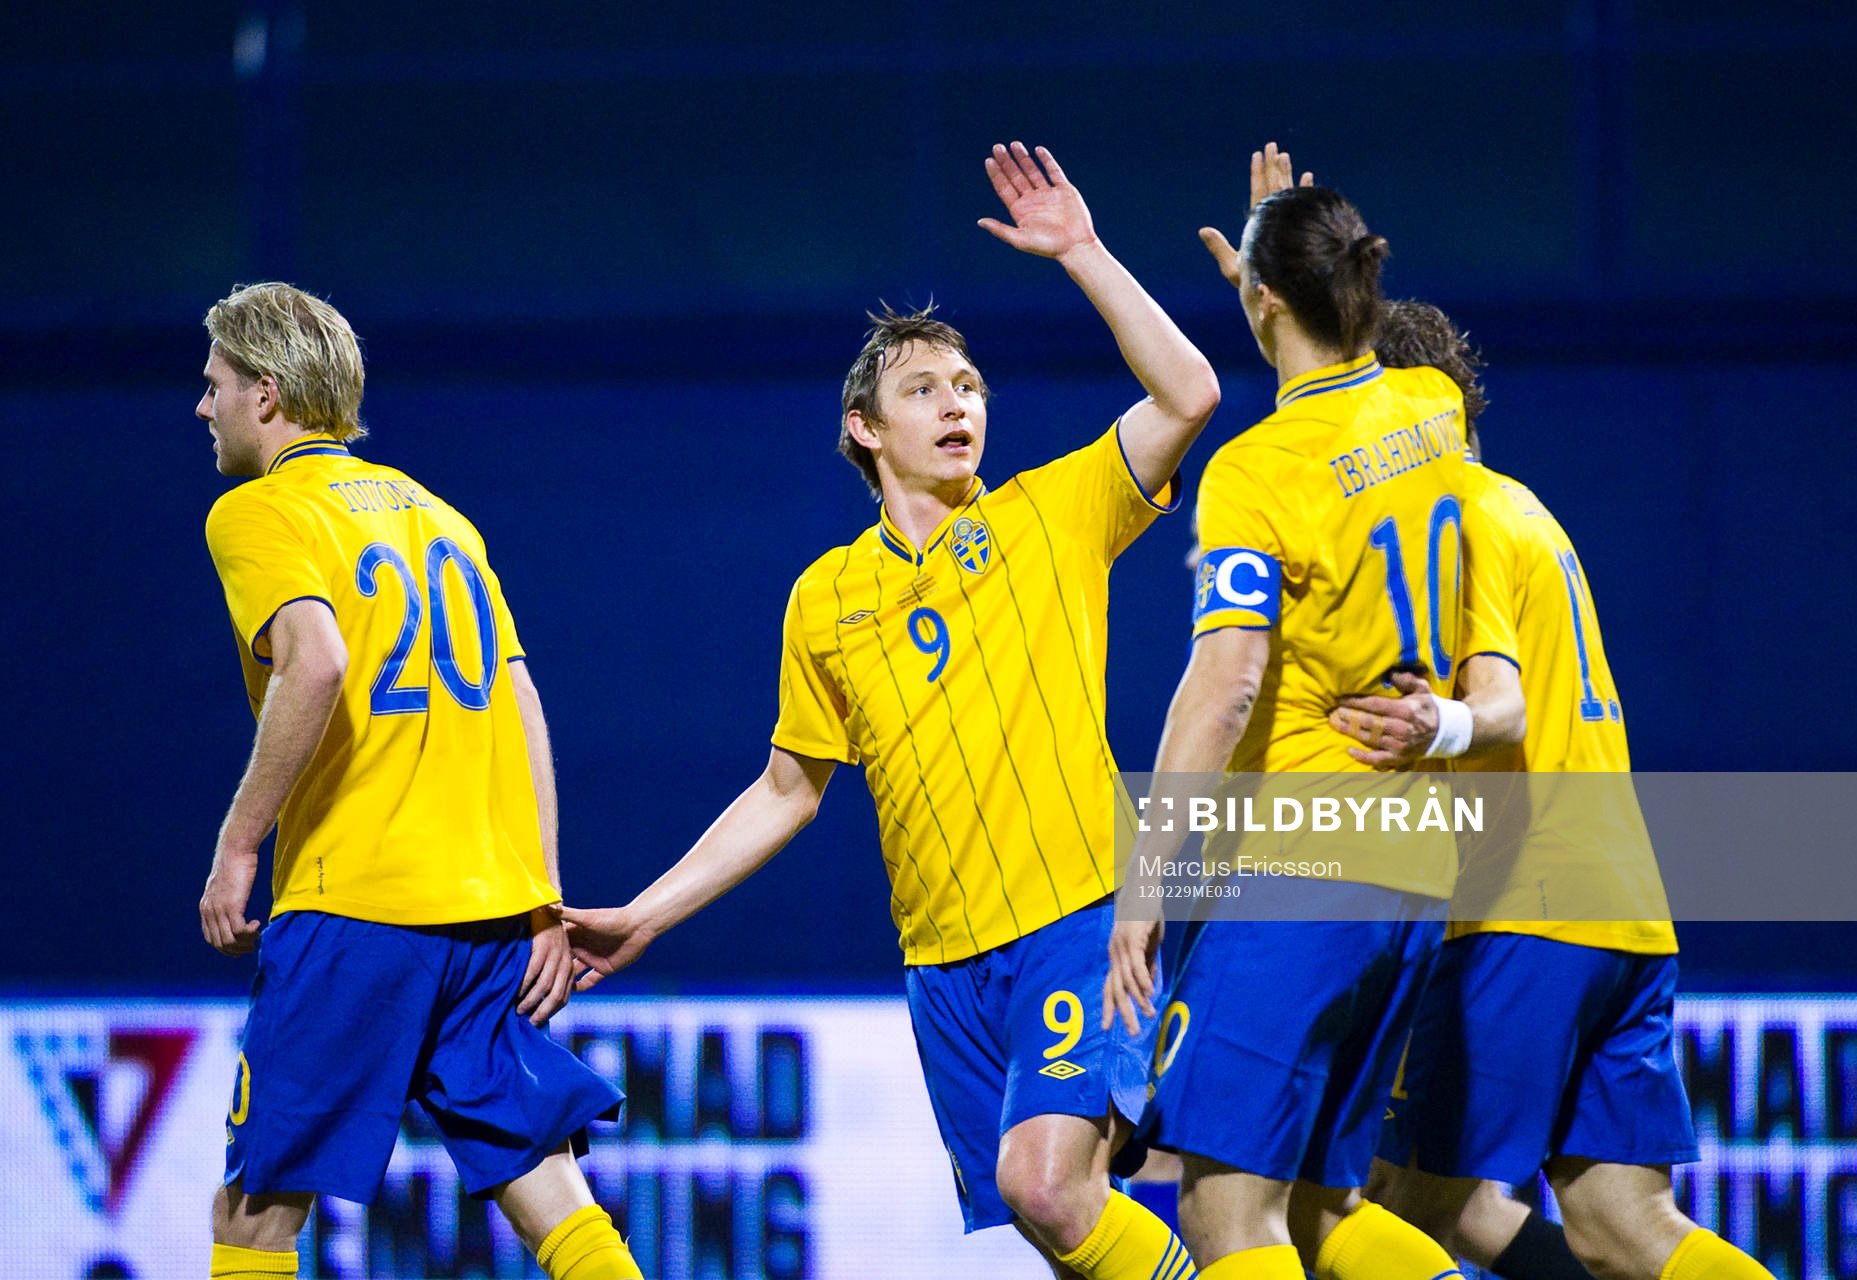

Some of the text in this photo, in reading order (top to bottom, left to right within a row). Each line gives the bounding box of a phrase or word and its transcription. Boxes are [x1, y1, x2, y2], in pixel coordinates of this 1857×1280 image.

[1215, 551, 1270, 607] C
[1367, 493, 1463, 689] 10
[356, 536, 499, 716] 20
[907, 606, 951, 683] 9
[1042, 990, 1085, 1059] 9
